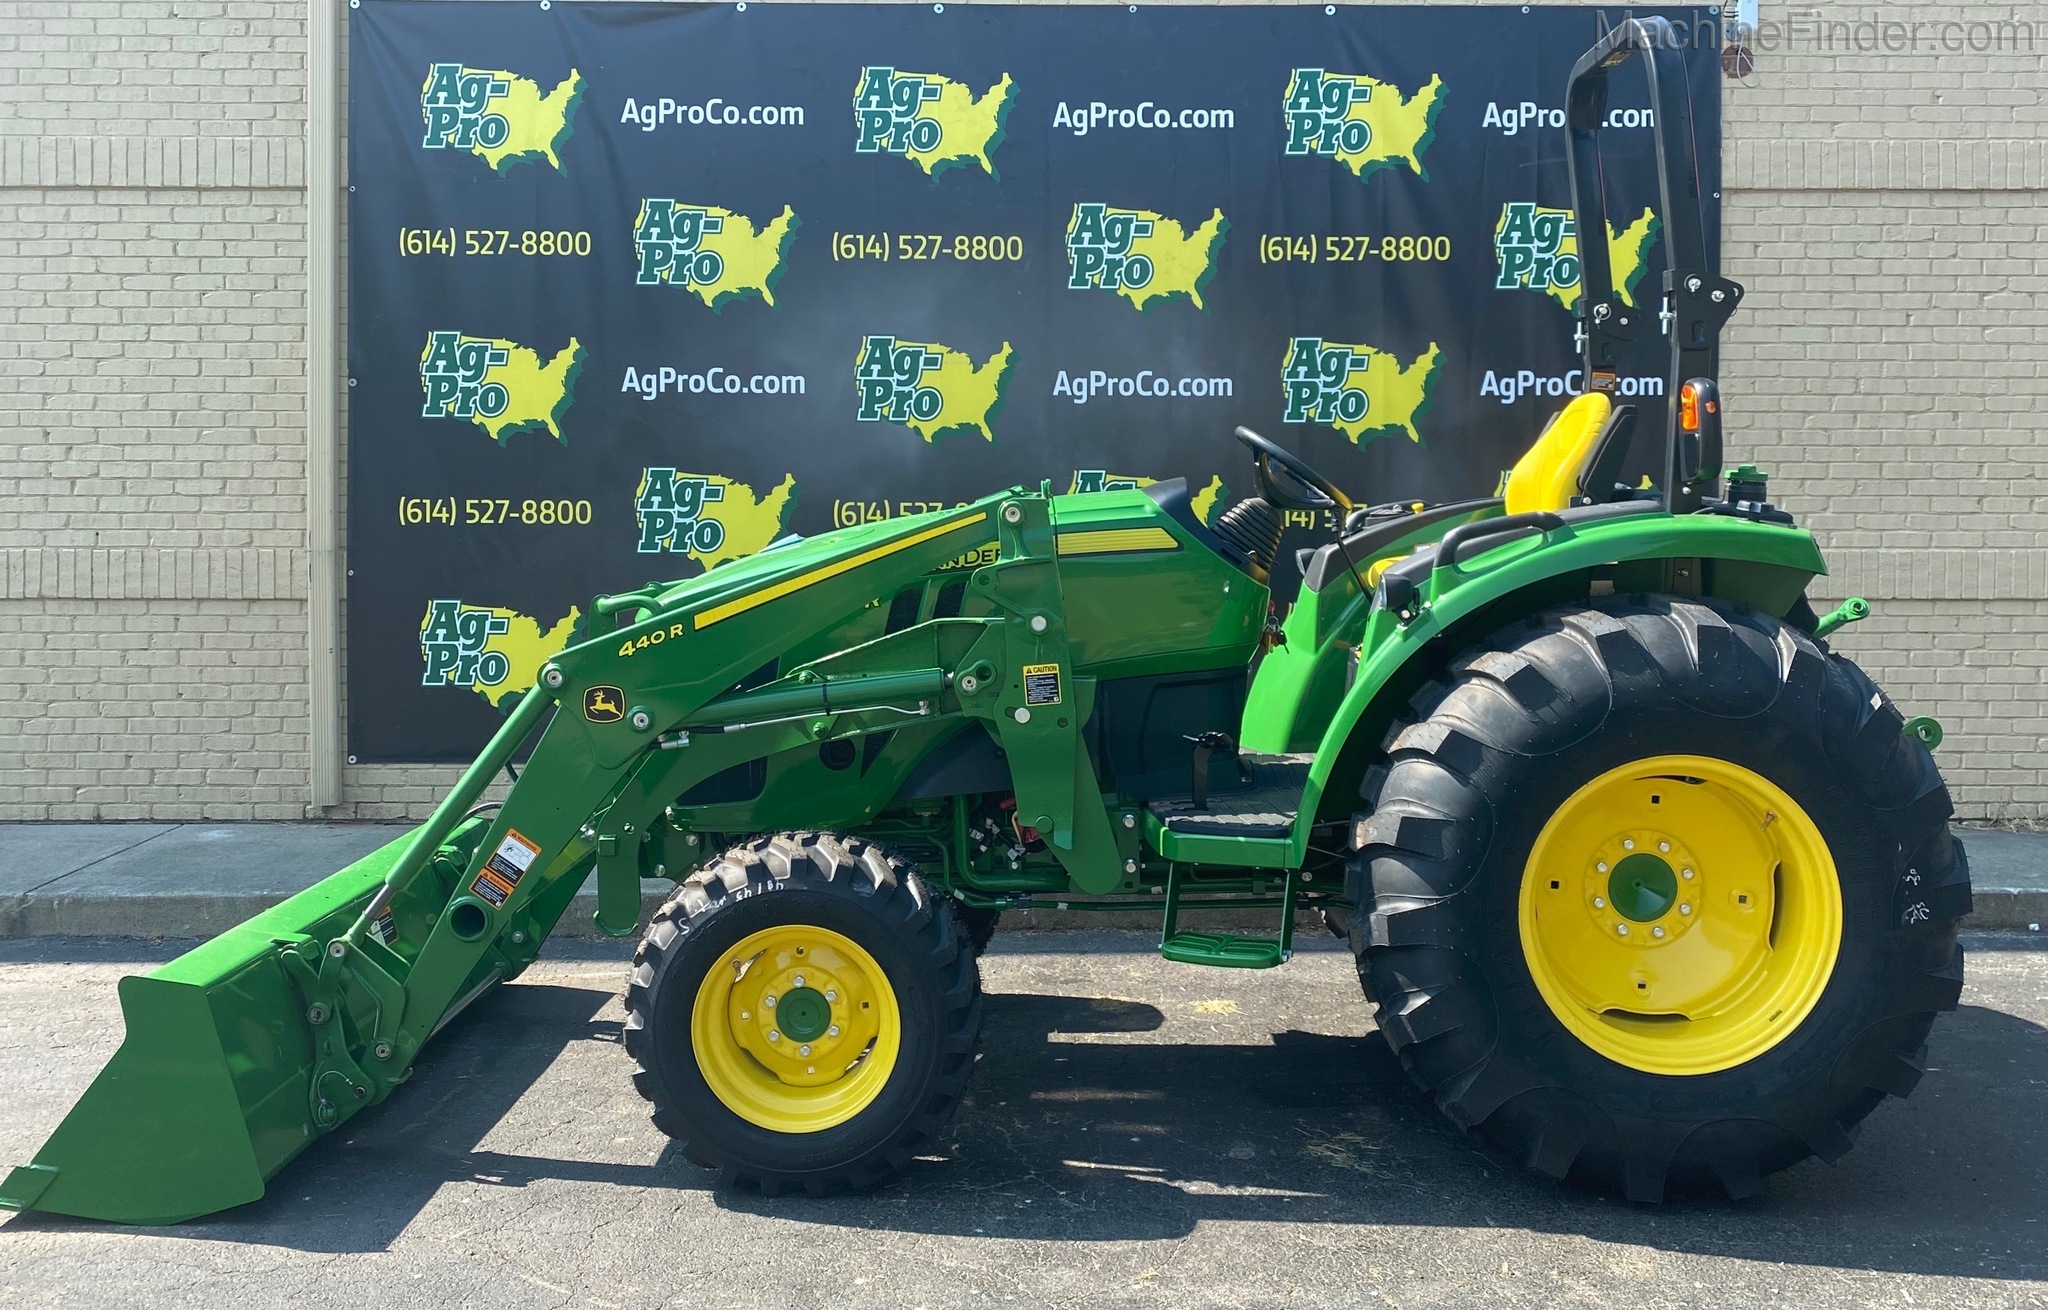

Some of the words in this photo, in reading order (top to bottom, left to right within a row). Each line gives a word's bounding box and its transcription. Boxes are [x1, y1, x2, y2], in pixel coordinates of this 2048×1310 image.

[423, 64, 509, 116] Ag-
[856, 67, 942, 119] Ag-
[1285, 69, 1371, 121] Ag-
[423, 105, 508, 148] Pro
[621, 98, 803, 131] AgProCo.com
[856, 108, 941, 152] Pro
[1053, 102, 1234, 135] AgProCo.com
[1285, 110, 1370, 154] Pro
[400, 228, 456, 257] (614)
[466, 231, 591, 256] 527-8800
[636, 199, 722, 251] Ag-
[833, 232, 889, 261] (614)
[899, 235, 1023, 260] 527-8800
[1068, 203, 1154, 255] Ag-
[636, 240, 722, 284] Pro
[1068, 244, 1152, 288] Pro
[1261, 235, 1316, 263] (614)
[1327, 237, 1451, 262] 527-8800
[1497, 244, 1579, 288] Pro
[422, 332, 508, 384] Ag-
[857, 336, 943, 388] Ag-
[1284, 338, 1370, 390] Ag-
[422, 373, 507, 417] Pro
[622, 367, 805, 400] AgProCo.com
[857, 377, 941, 420] Pro
[1053, 371, 1232, 403] AgProCo.com
[1284, 379, 1368, 422] Pro
[400, 497, 456, 526] (614)
[466, 500, 592, 525] 527-8800
[637, 468, 723, 520] Ag-
[637, 509, 723, 552] Pro
[422, 601, 508, 653] Ag-
[619, 630, 666, 657] 440
[670, 624, 683, 639] R
[422, 642, 508, 685] Pro
[1033, 665, 1058, 674] CAUTION
